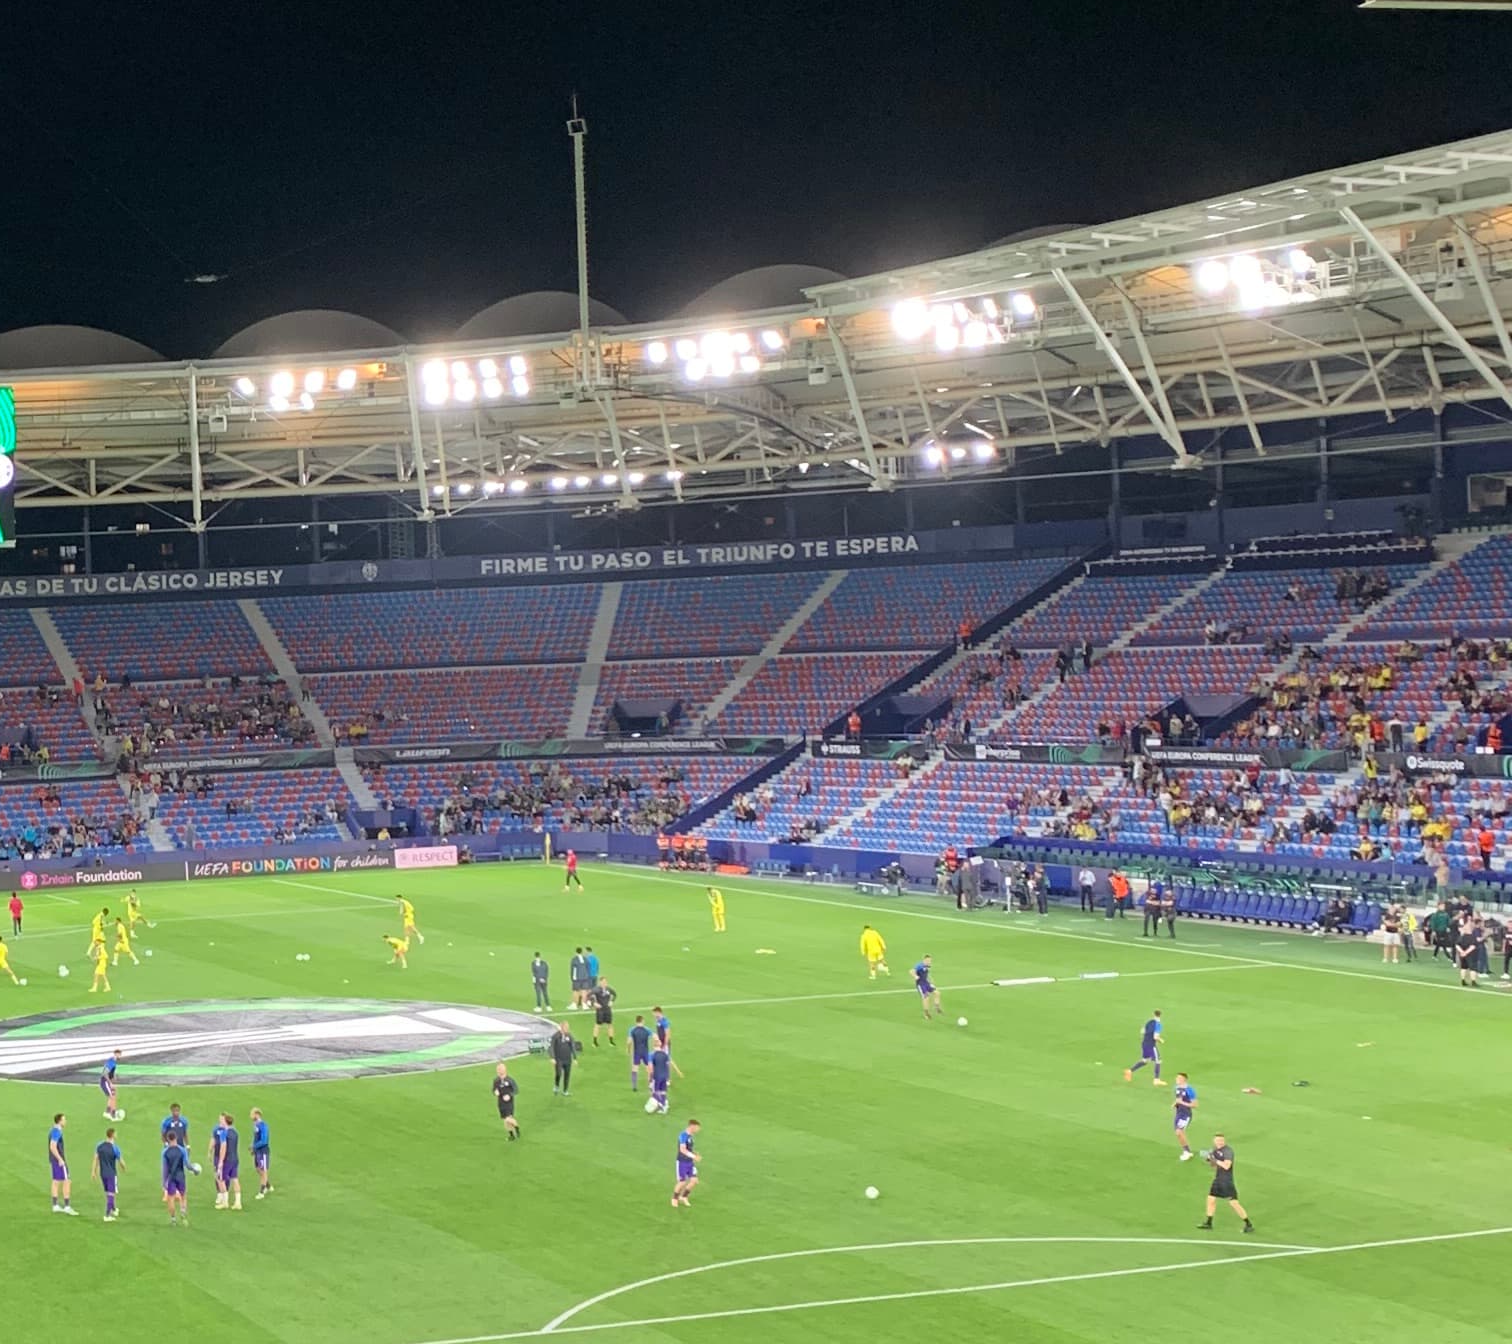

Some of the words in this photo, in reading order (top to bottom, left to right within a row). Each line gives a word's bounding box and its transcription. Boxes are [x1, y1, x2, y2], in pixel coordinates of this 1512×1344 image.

[480, 556, 548, 574] FIRME
[555, 555, 584, 571] TU
[591, 551, 651, 569] PASO
[663, 549, 689, 566] EL
[696, 543, 795, 564] TRIUNFO
[801, 541, 829, 558] TE
[836, 535, 919, 556] ESPERA
[37, 578, 64, 594] DE
[71, 577, 98, 593] TU
[105, 571, 197, 592] CLÁSICO
[204, 569, 283, 588] JERSEY
[1416, 758, 1465, 771] Swissquote
[195, 862, 229, 877] UEFA
[333, 855, 349, 872] for
[350, 853, 389, 869] children
[412, 851, 454, 862] RESPECT
[75, 868, 142, 884] Foundation
